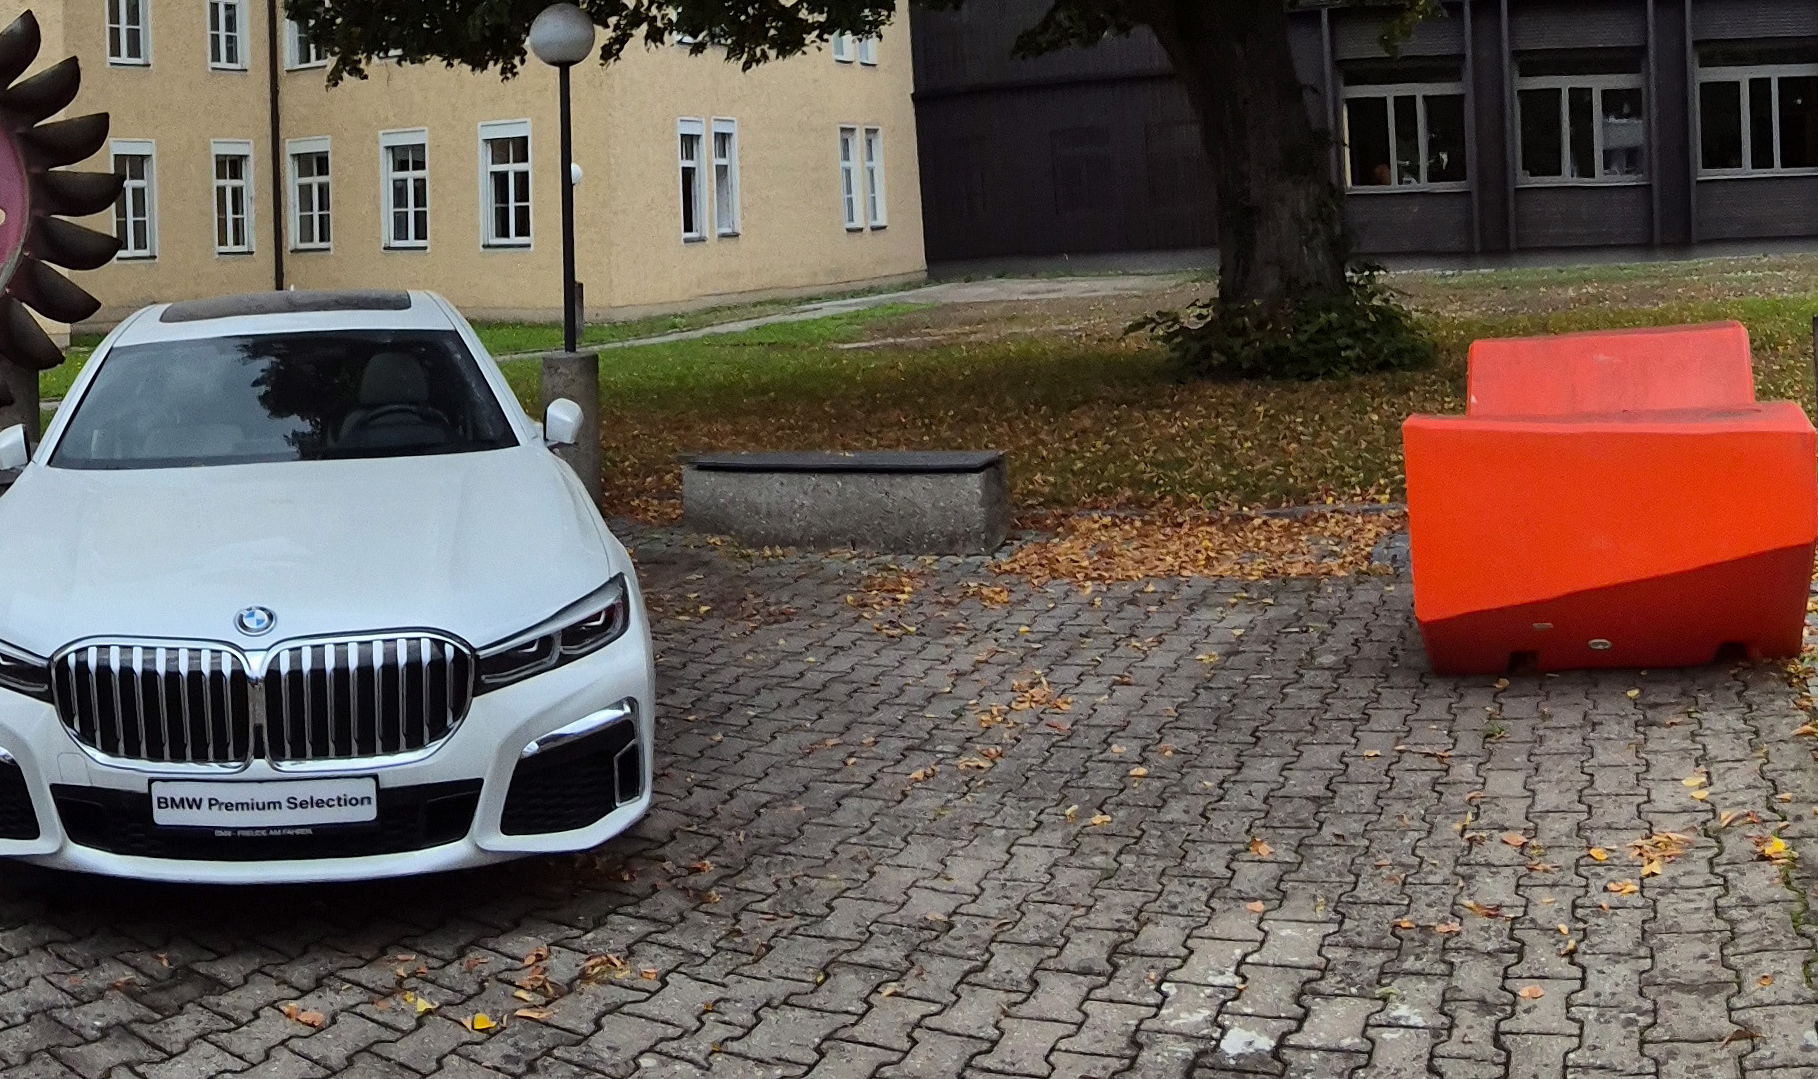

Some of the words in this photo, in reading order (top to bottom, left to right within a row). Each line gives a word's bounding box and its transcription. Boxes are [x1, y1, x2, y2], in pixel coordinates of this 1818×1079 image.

[156, 795, 203, 810] BMW
[208, 797, 283, 812] Premium
[286, 794, 372, 810] Selection
